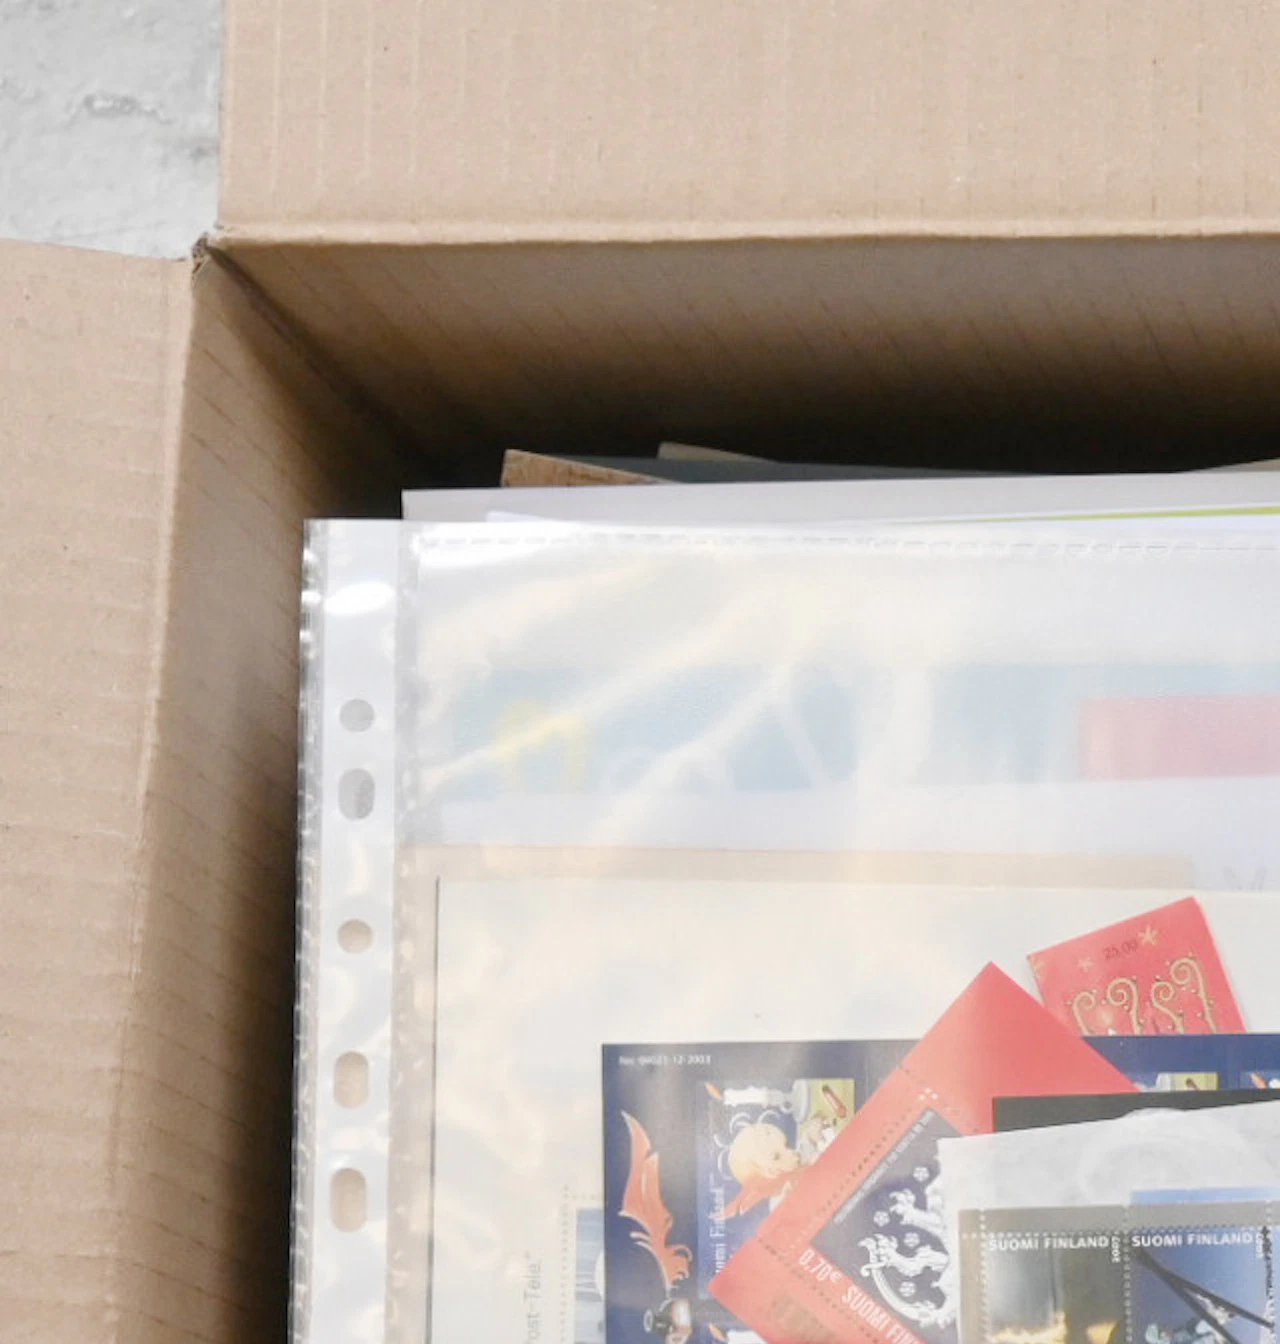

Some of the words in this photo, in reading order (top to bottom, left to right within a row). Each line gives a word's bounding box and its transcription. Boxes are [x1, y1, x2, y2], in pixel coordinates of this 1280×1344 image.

[989, 1239, 1039, 1251] SUOMI
[1044, 1235, 1109, 1250] FINLAND
[1132, 1235, 1182, 1248] SUOMI
[1187, 1232, 1253, 1246] FINLAND
[841, 1284, 892, 1331] SUOMI
